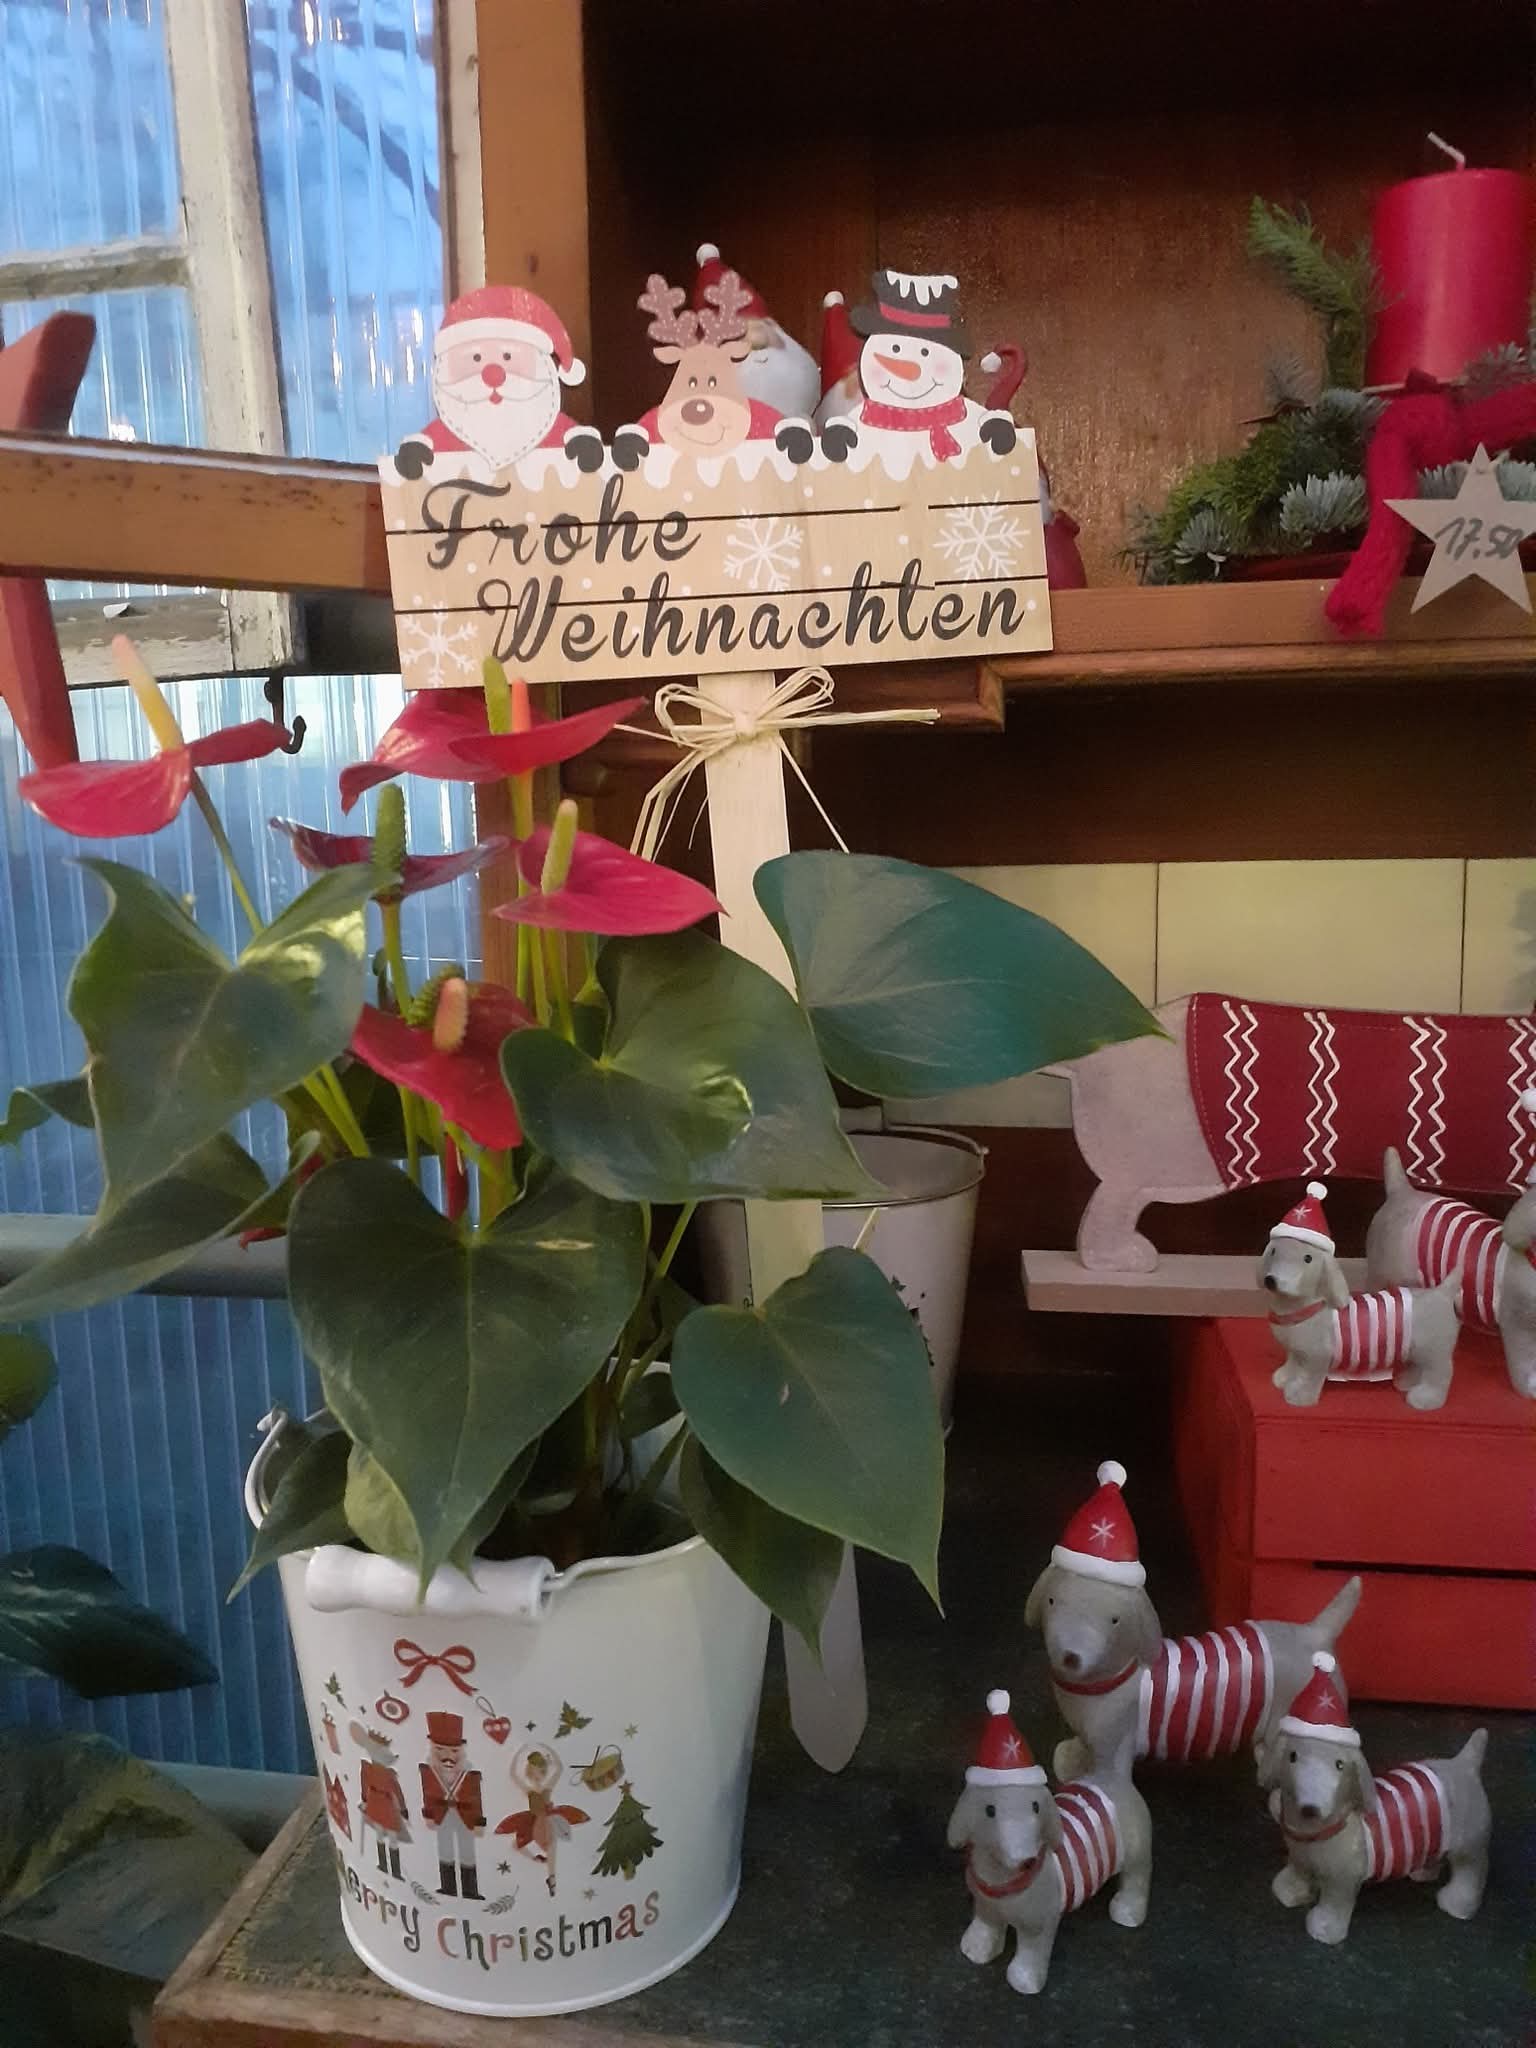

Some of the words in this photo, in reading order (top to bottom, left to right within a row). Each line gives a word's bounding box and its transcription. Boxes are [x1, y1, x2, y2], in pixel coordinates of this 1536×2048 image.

[421, 473, 701, 570] Frohe
[477, 558, 1025, 664] Weihnachten
[437, 1890, 660, 1970] Christmas
